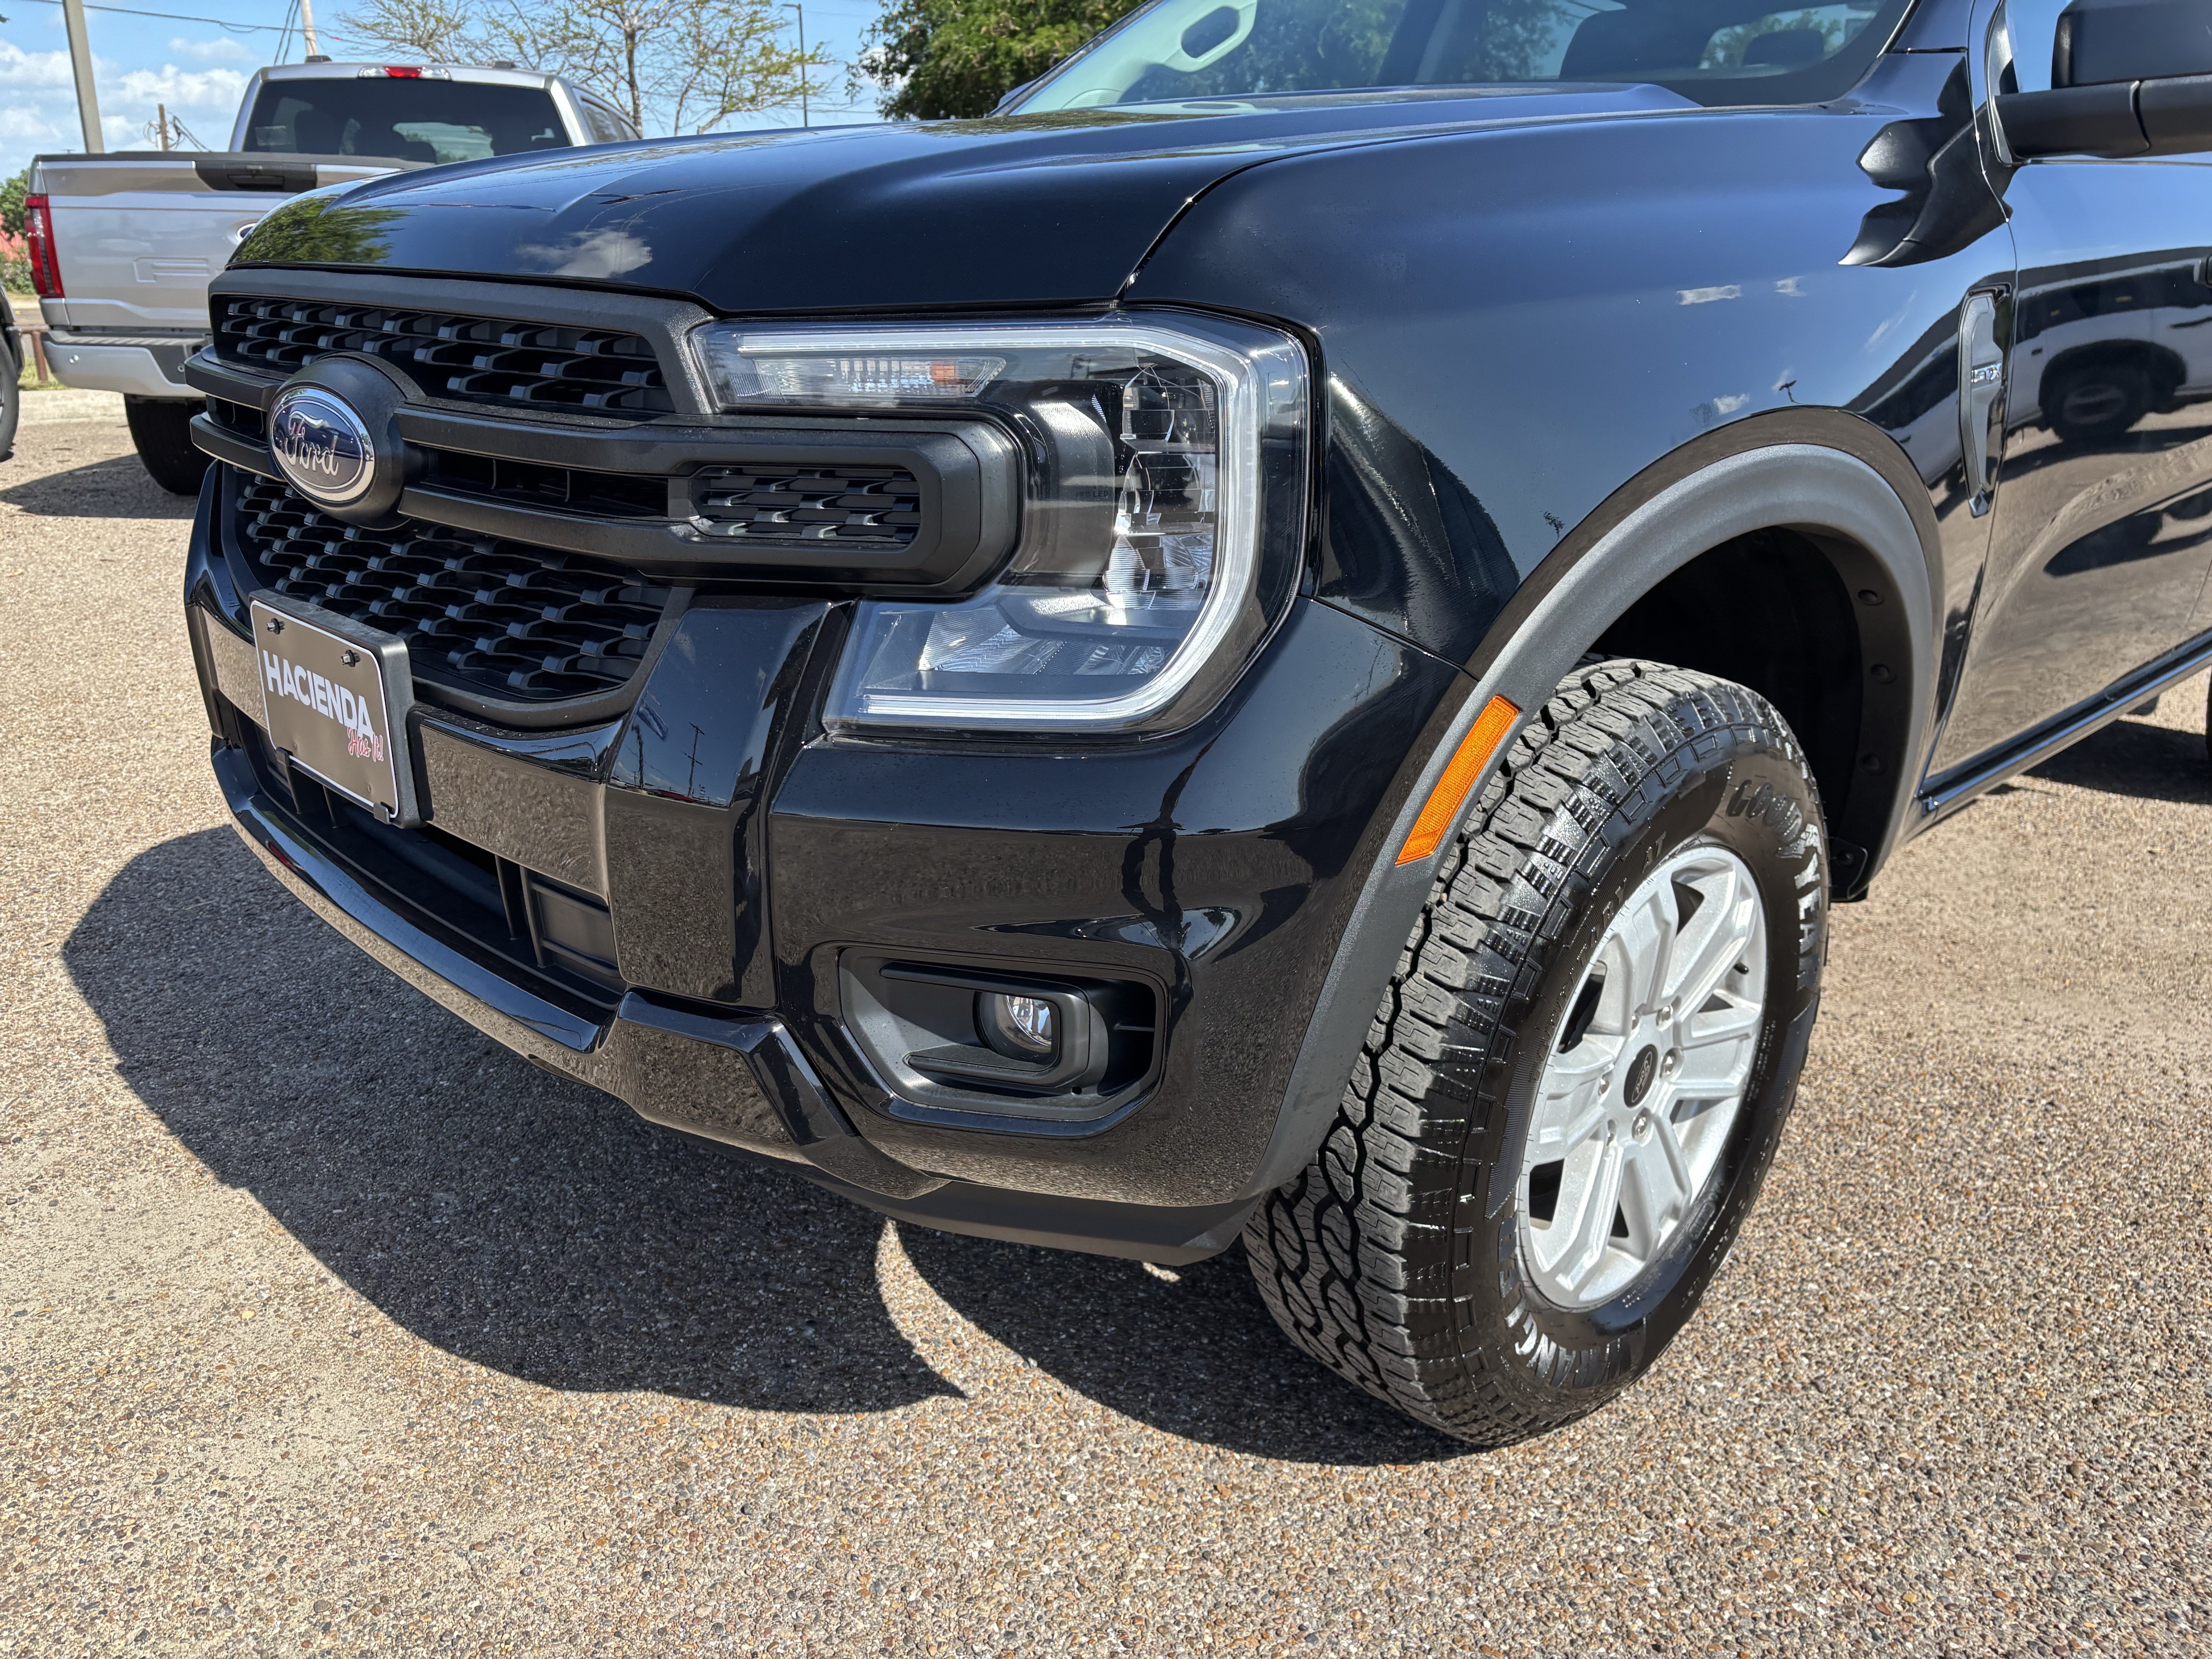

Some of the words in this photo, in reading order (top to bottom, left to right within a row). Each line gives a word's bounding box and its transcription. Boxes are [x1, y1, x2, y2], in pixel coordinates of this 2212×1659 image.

[285, 410, 338, 476] Ford
[263, 650, 373, 738] HACIENDA
[347, 726, 371, 758] Has
[372, 733, 384, 763] It!
[1635, 1060, 1649, 1094] Ford
